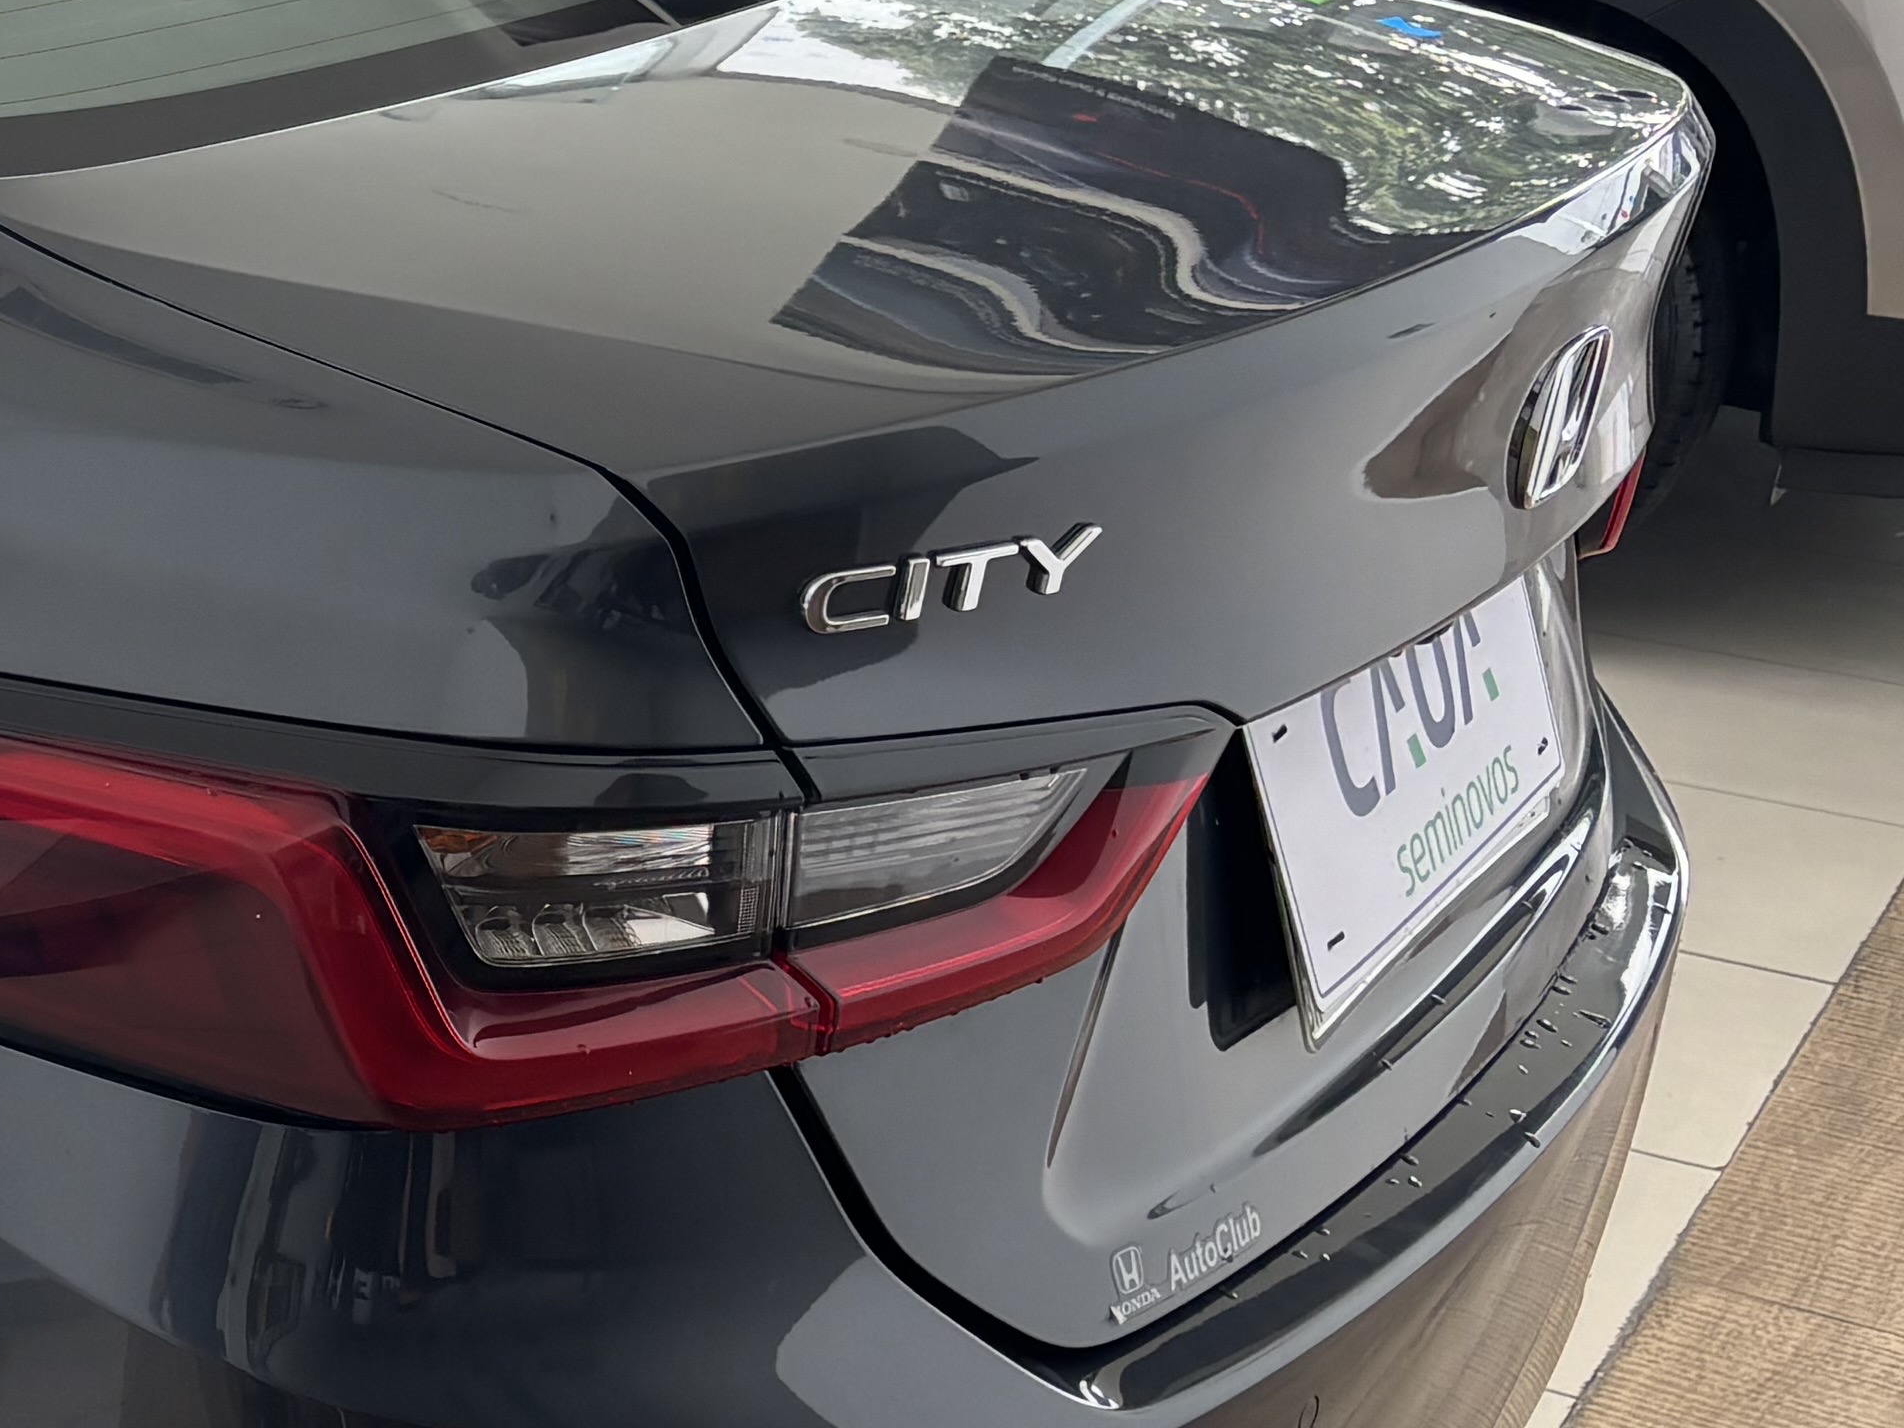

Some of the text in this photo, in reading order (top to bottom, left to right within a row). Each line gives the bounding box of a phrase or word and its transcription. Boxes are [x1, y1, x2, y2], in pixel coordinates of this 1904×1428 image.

[799, 522, 1103, 635] CITY
[1396, 744, 1520, 898] seminovos
[1168, 1203, 1262, 1292] AutoClub
